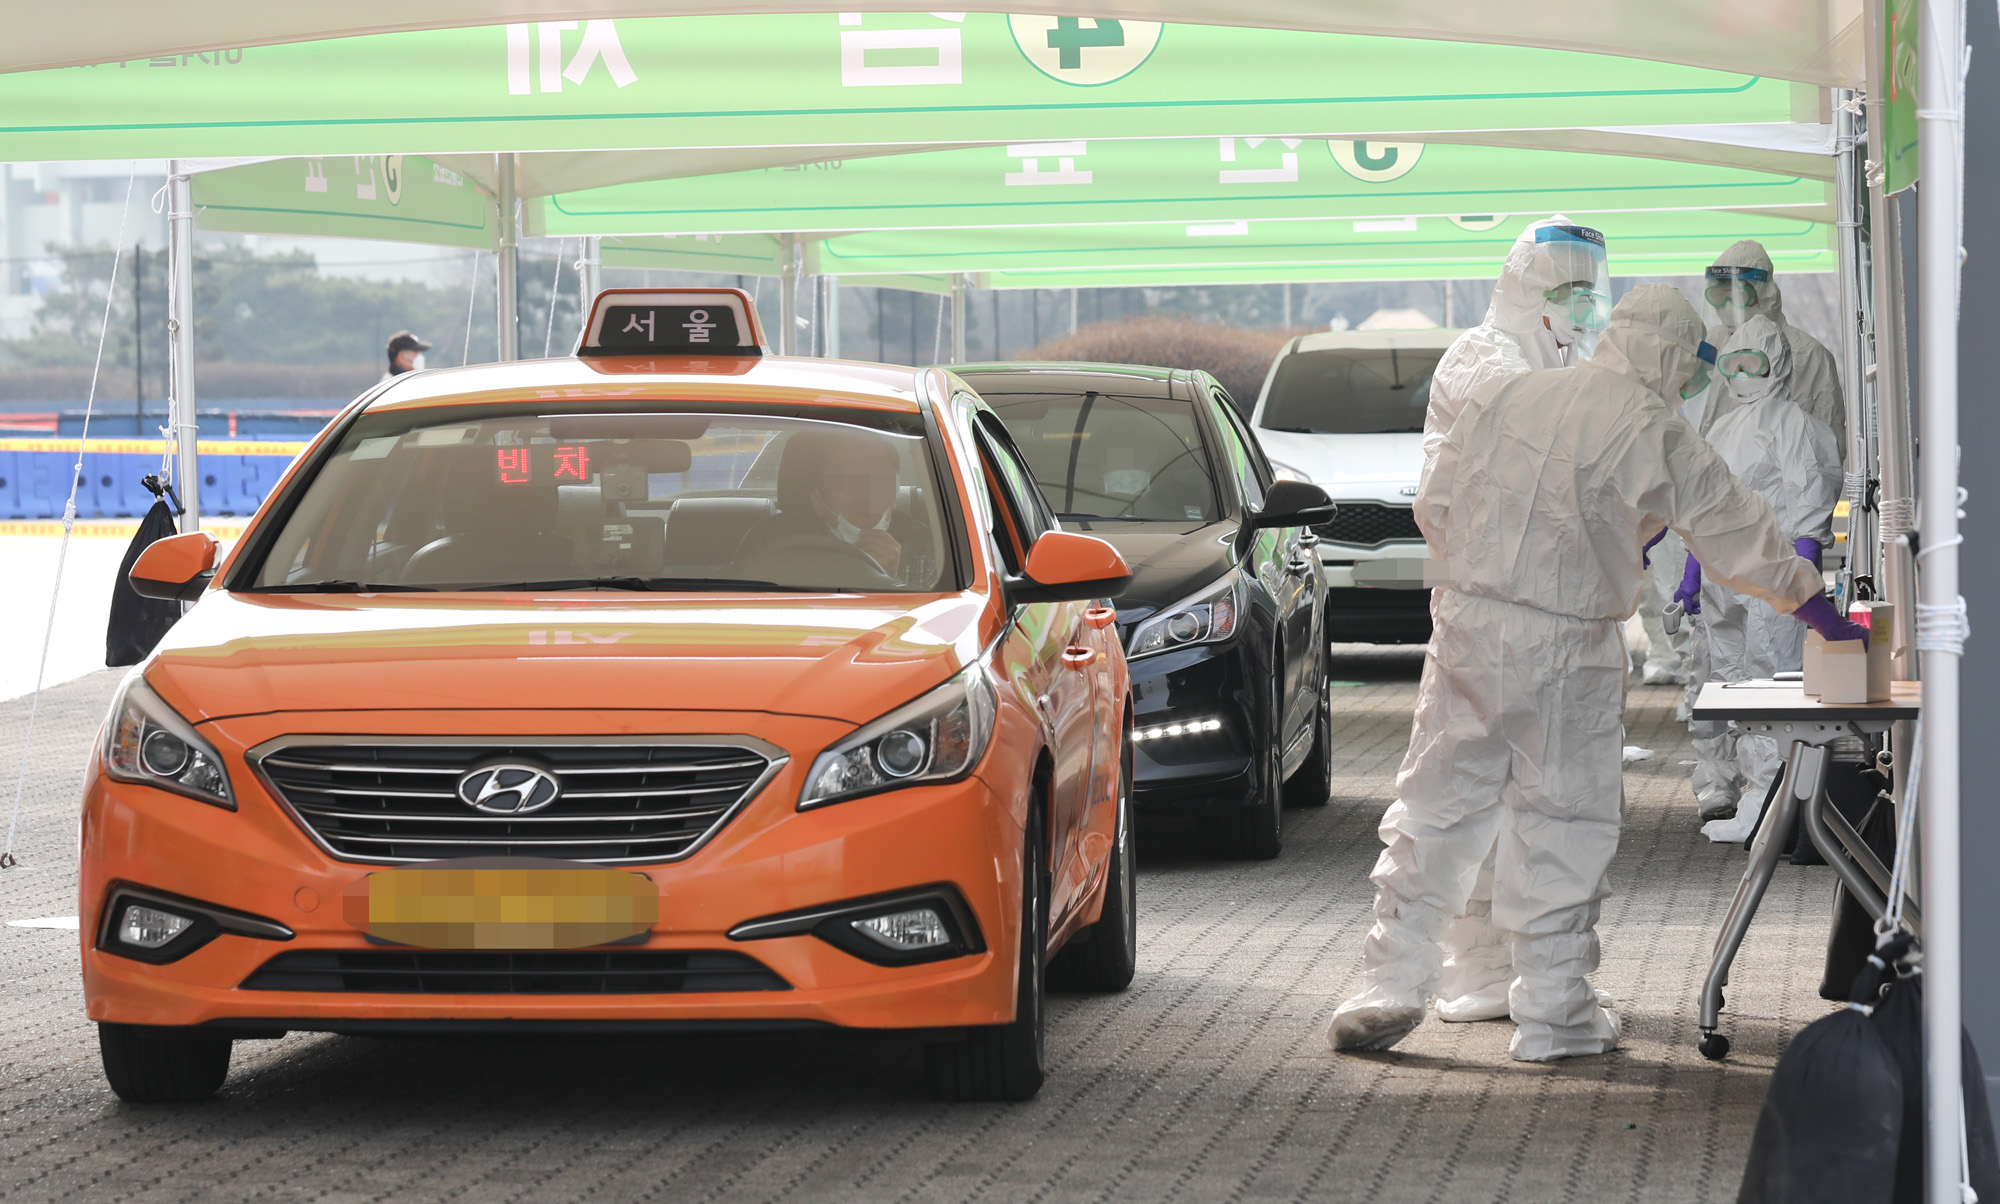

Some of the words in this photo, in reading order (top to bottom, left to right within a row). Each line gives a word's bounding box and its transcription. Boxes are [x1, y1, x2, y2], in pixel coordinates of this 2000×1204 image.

[1581, 228, 1595, 239] Face
[1711, 267, 1721, 275] Face
[1722, 267, 1740, 275] Shid
[622, 309, 717, 343] 서울
[498, 446, 590, 483] 빈차
